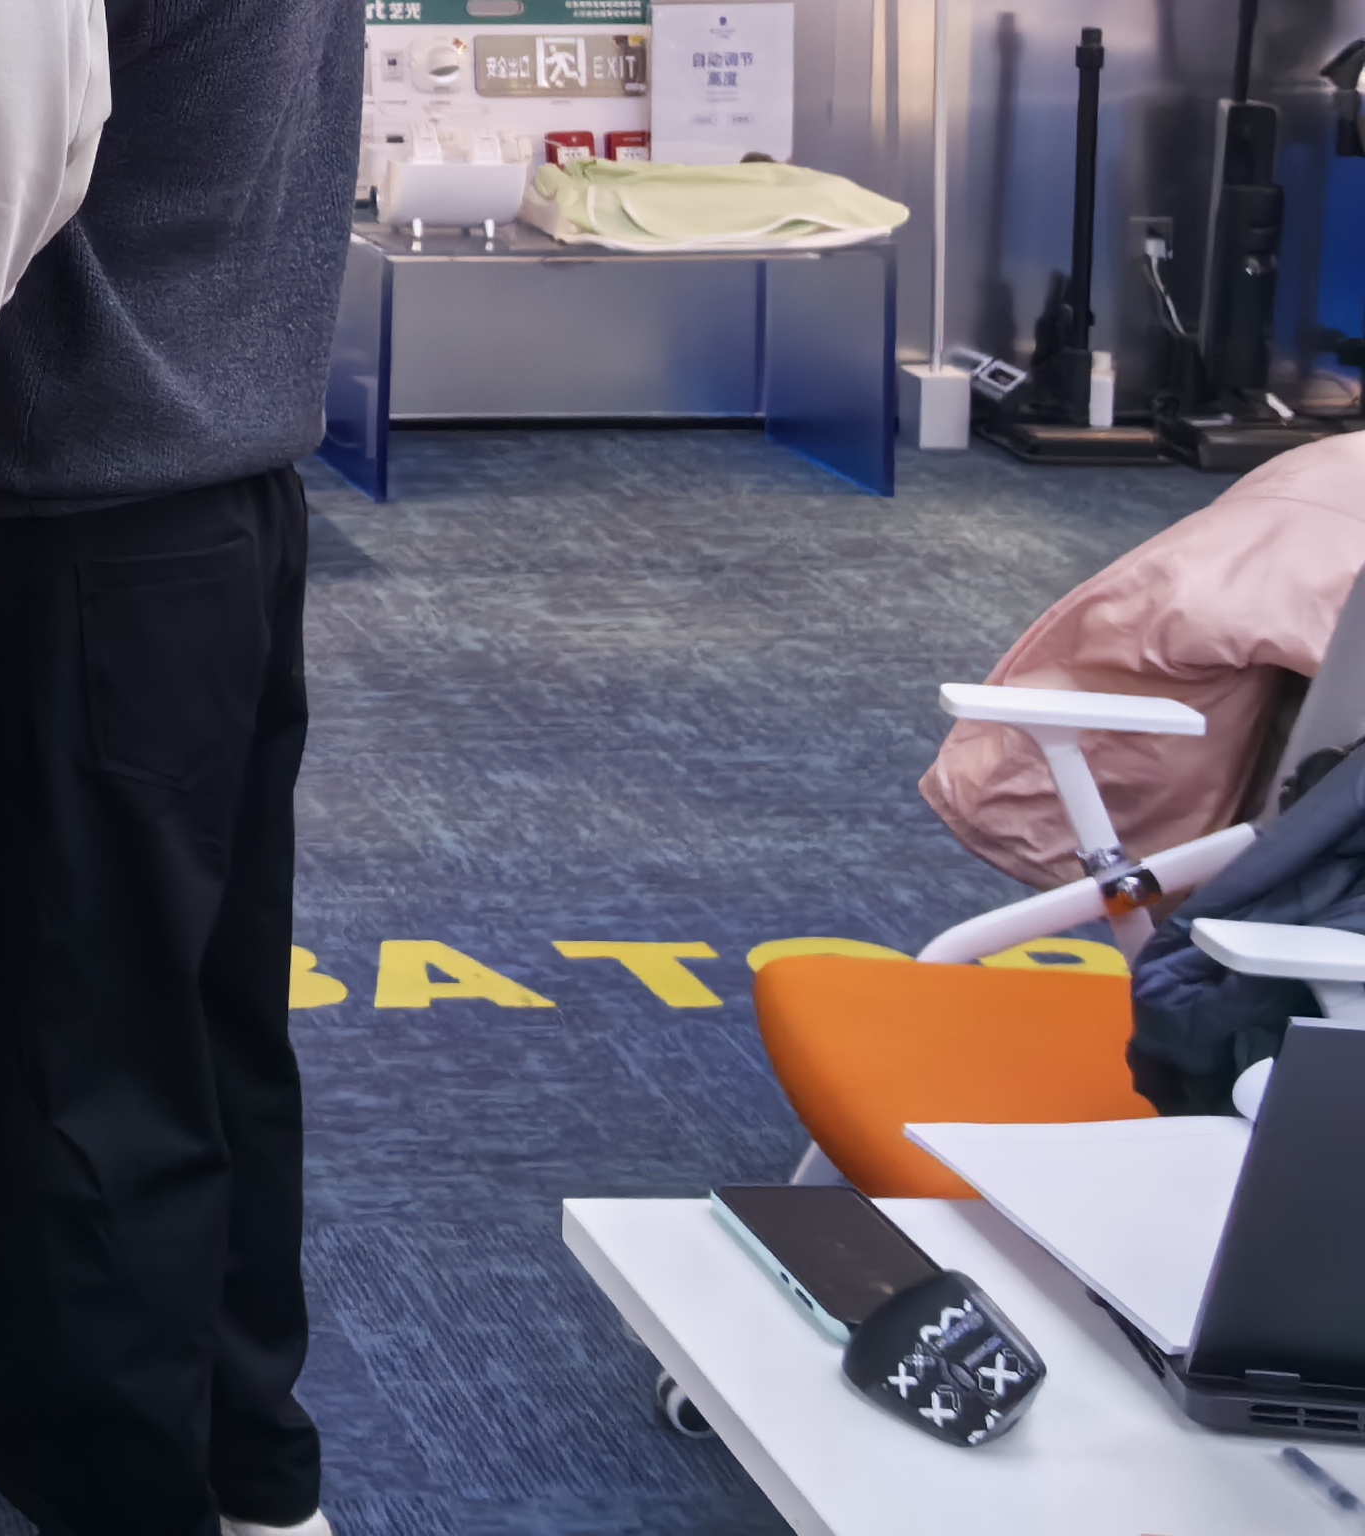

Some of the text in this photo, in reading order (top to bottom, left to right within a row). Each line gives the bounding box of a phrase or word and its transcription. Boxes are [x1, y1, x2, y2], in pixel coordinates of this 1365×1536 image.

[486, 56, 637, 79] 安全出口 EXIT
